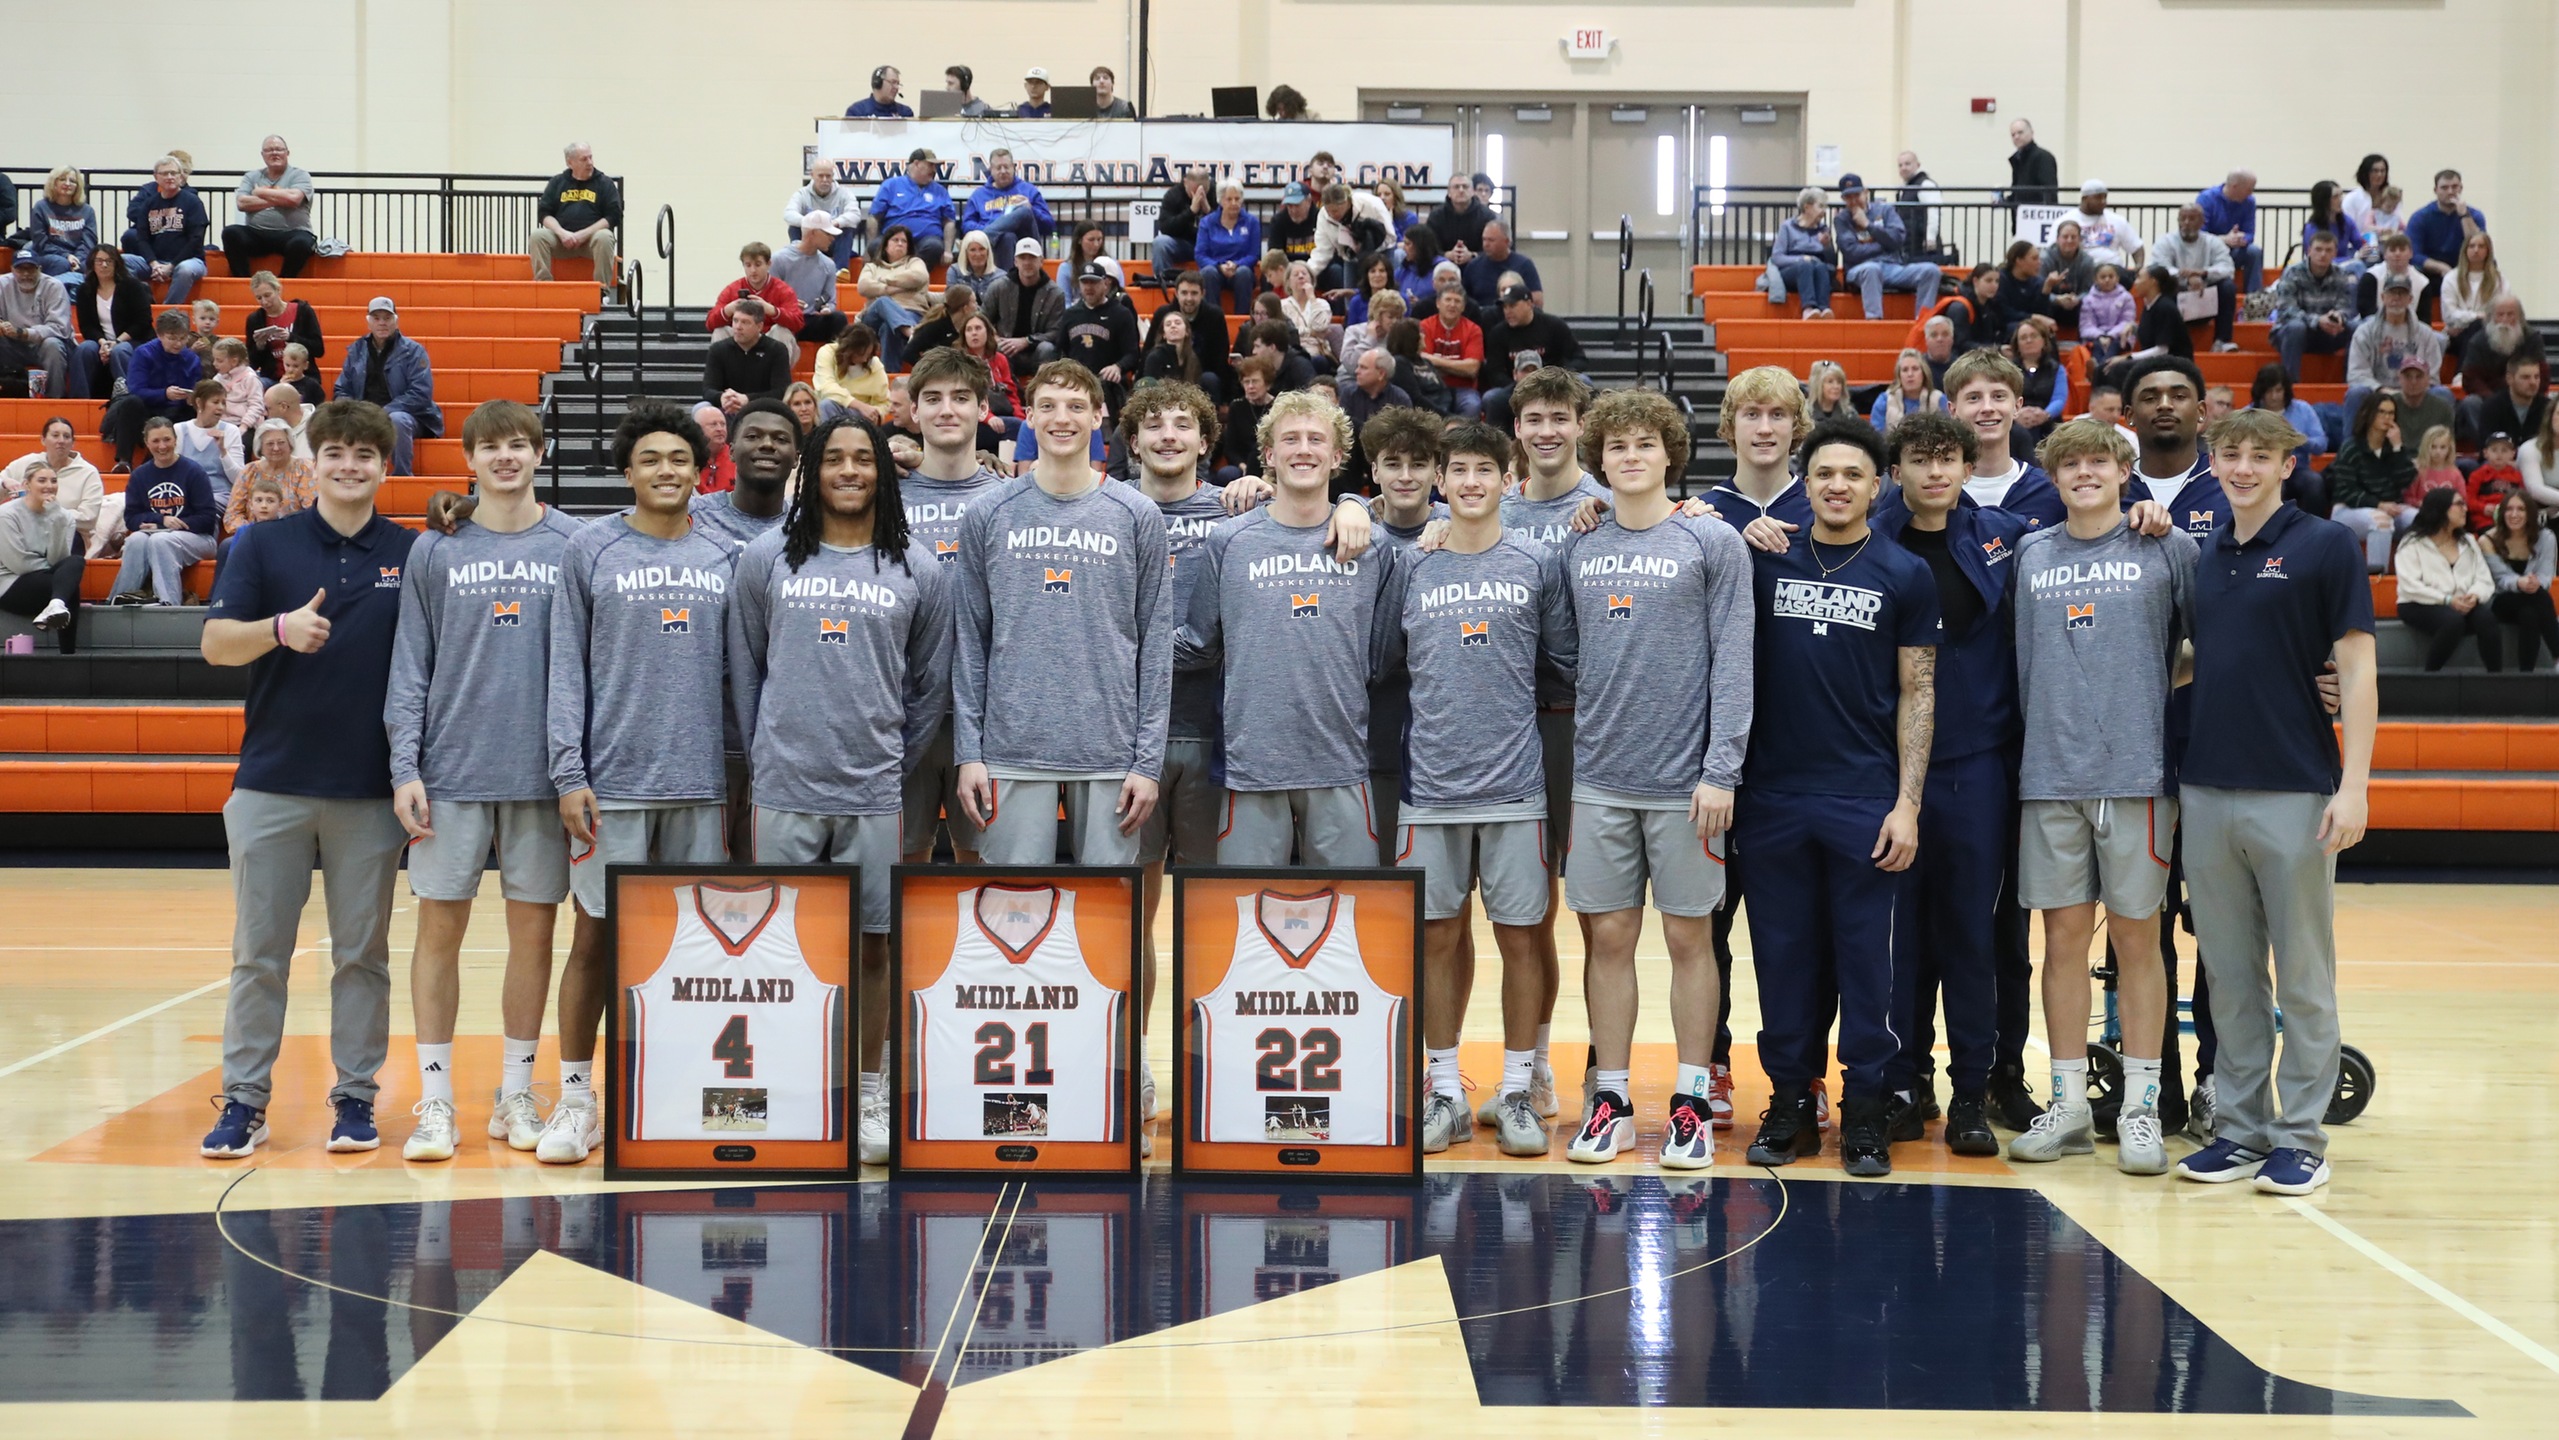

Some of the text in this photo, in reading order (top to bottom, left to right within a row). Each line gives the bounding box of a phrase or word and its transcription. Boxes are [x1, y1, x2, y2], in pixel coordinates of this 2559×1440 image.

[1577, 30, 1603, 49] EXIT
[1007, 526, 1118, 556] MIDLAND
[1015, 552, 1108, 565] BASKETBALL
[1249, 553, 1358, 581] MIDLAND
[1580, 554, 1679, 579] MIDLAND
[616, 566, 725, 595] MIDLAND
[1258, 578, 1352, 589] BASKETBALL
[1583, 580, 1668, 589] BASKETBALL
[2030, 561, 2142, 593] MIDLAND
[627, 592, 720, 604] BASKETBALL
[781, 577, 896, 608] MIDLAND
[1421, 581, 1529, 611] MIDLAND
[1775, 582, 1882, 613] MIDLAND
[2036, 585, 2131, 600] BASKETBALL
[788, 601, 885, 617] BASKETBALL
[1429, 606, 1522, 619] BASKETBALL
[1774, 599, 1877, 627] BASKETBALL
[672, 977, 795, 1003] MIDLAND
[955, 984, 1079, 1010] MIDLAND
[1235, 991, 1359, 1016] MIDLAND
[712, 1015, 754, 1079] 4
[974, 1021, 1054, 1086] 21
[1255, 1027, 1342, 1092] 22
